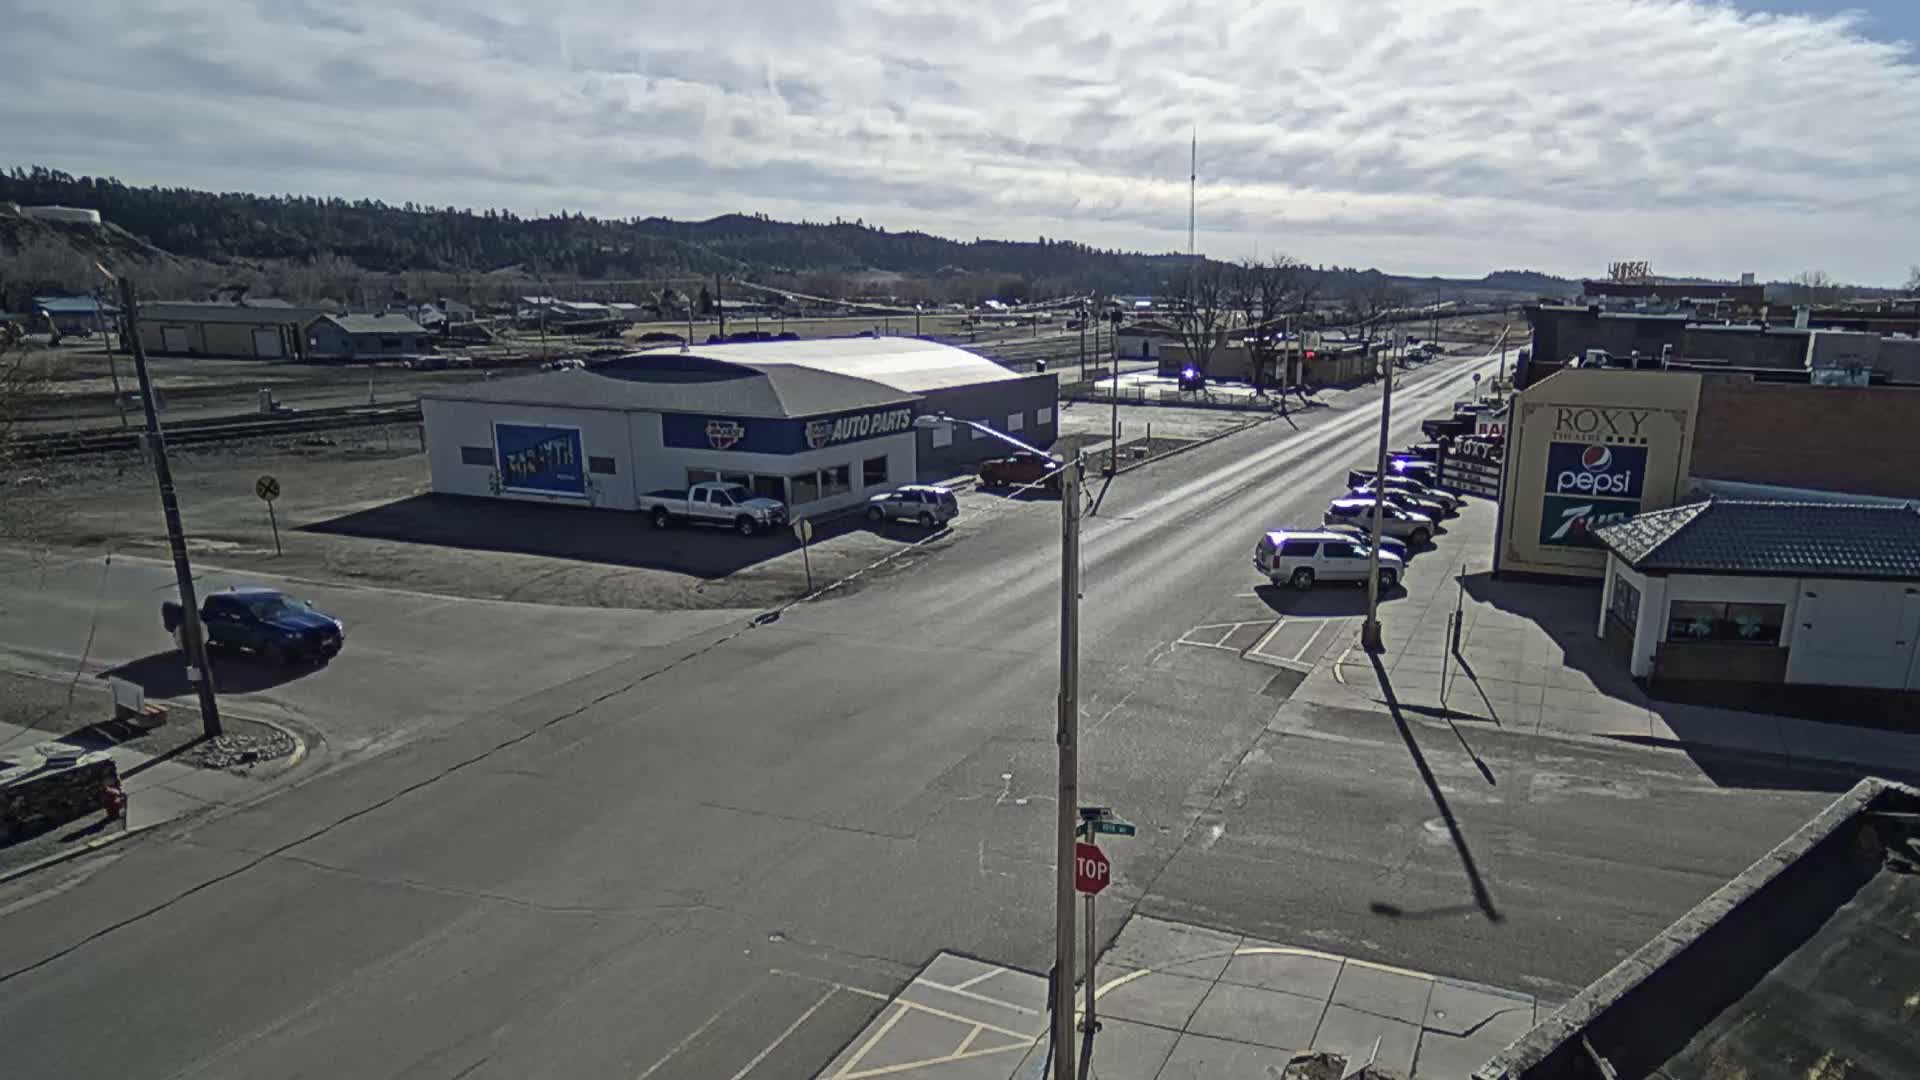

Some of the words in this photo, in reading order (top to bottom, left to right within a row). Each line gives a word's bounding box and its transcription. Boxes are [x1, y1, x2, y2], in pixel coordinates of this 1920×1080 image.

[831, 416, 870, 441] AUTO
[869, 409, 911, 436] PARTS
[1480, 423, 1506, 435] BA
[1556, 408, 1648, 435] ROXY
[1557, 470, 1631, 496] pepsi
[1076, 857, 1108, 881] TOP
